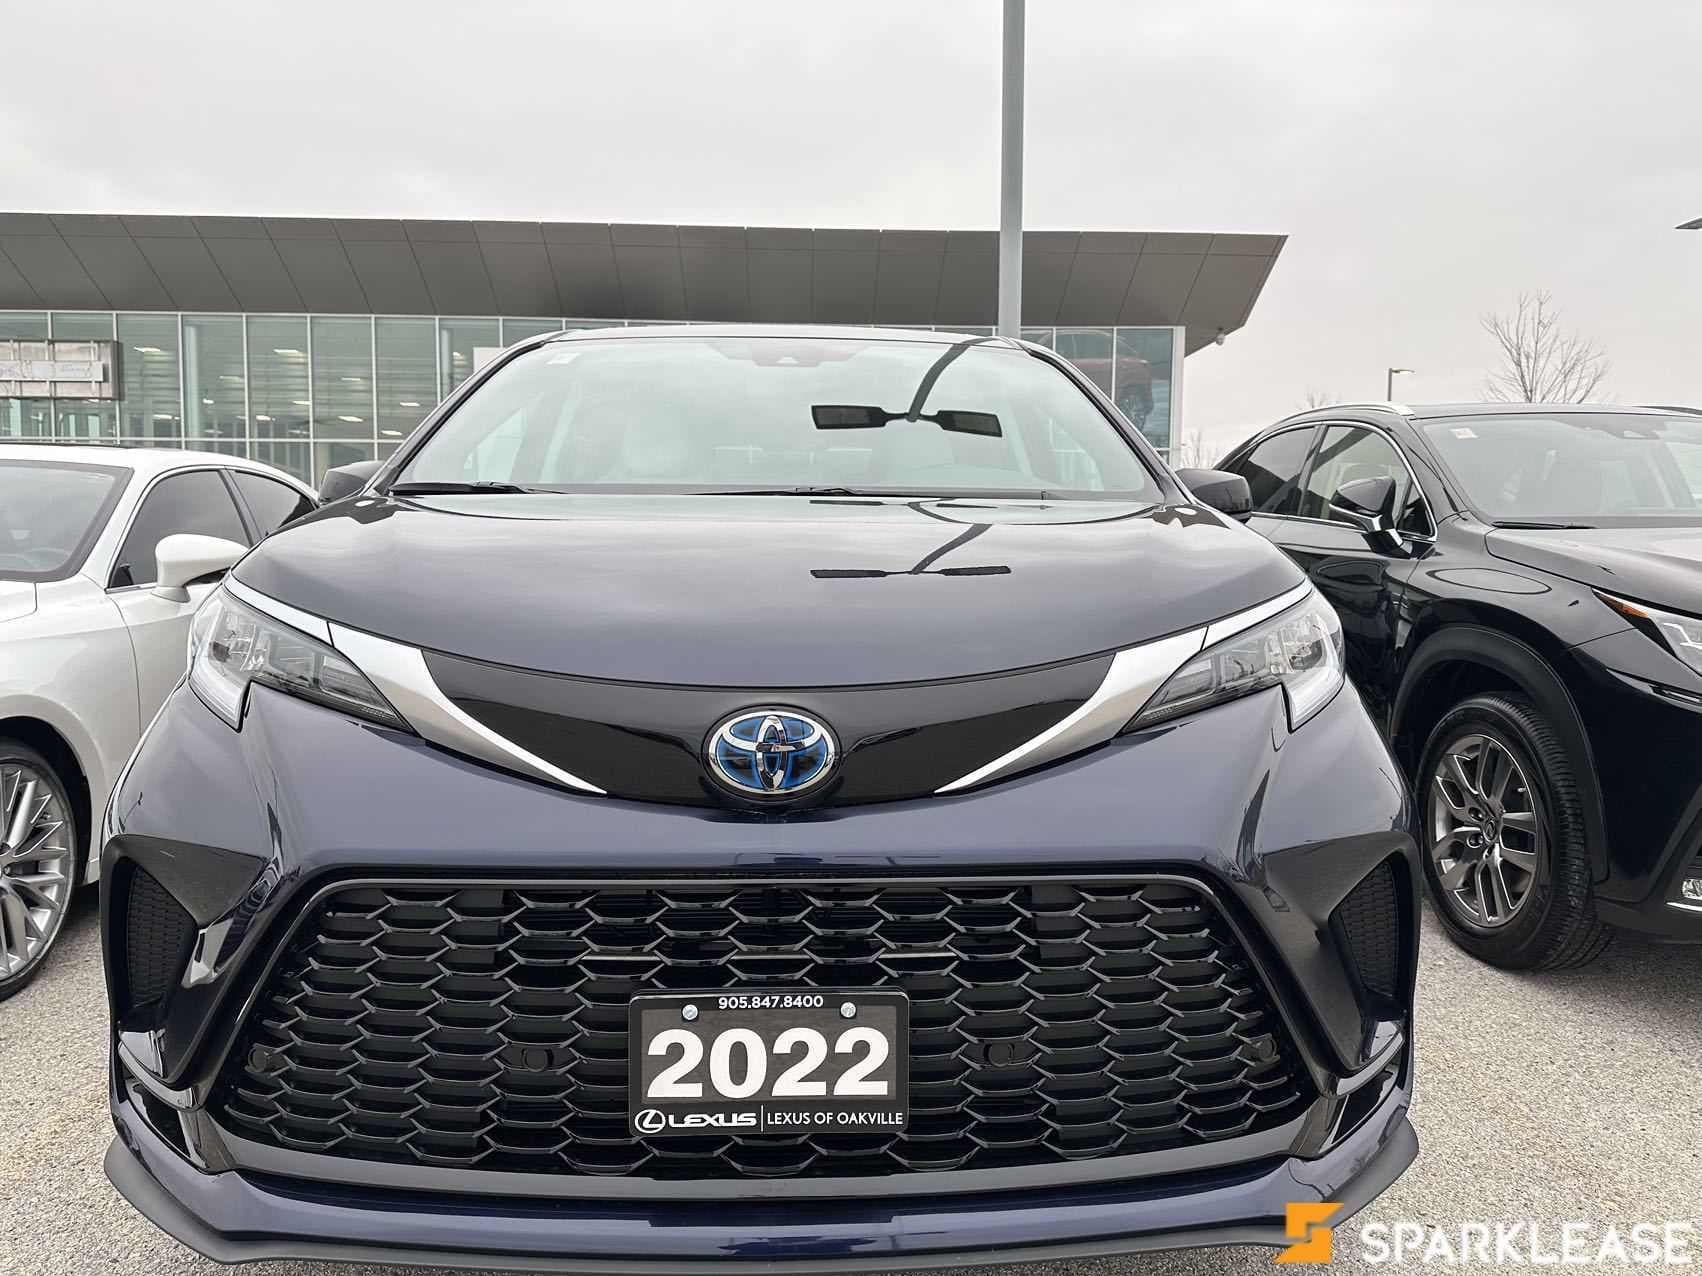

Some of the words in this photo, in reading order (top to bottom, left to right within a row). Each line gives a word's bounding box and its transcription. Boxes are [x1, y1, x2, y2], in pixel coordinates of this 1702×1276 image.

[718, 995, 824, 1010] 905.847.8400
[647, 1027, 889, 1099] 2022
[668, 1112, 757, 1128] LEXUS
[767, 1112, 810, 1125] LEXUS
[815, 1112, 834, 1125] OF
[839, 1112, 903, 1125] OAKVILLE
